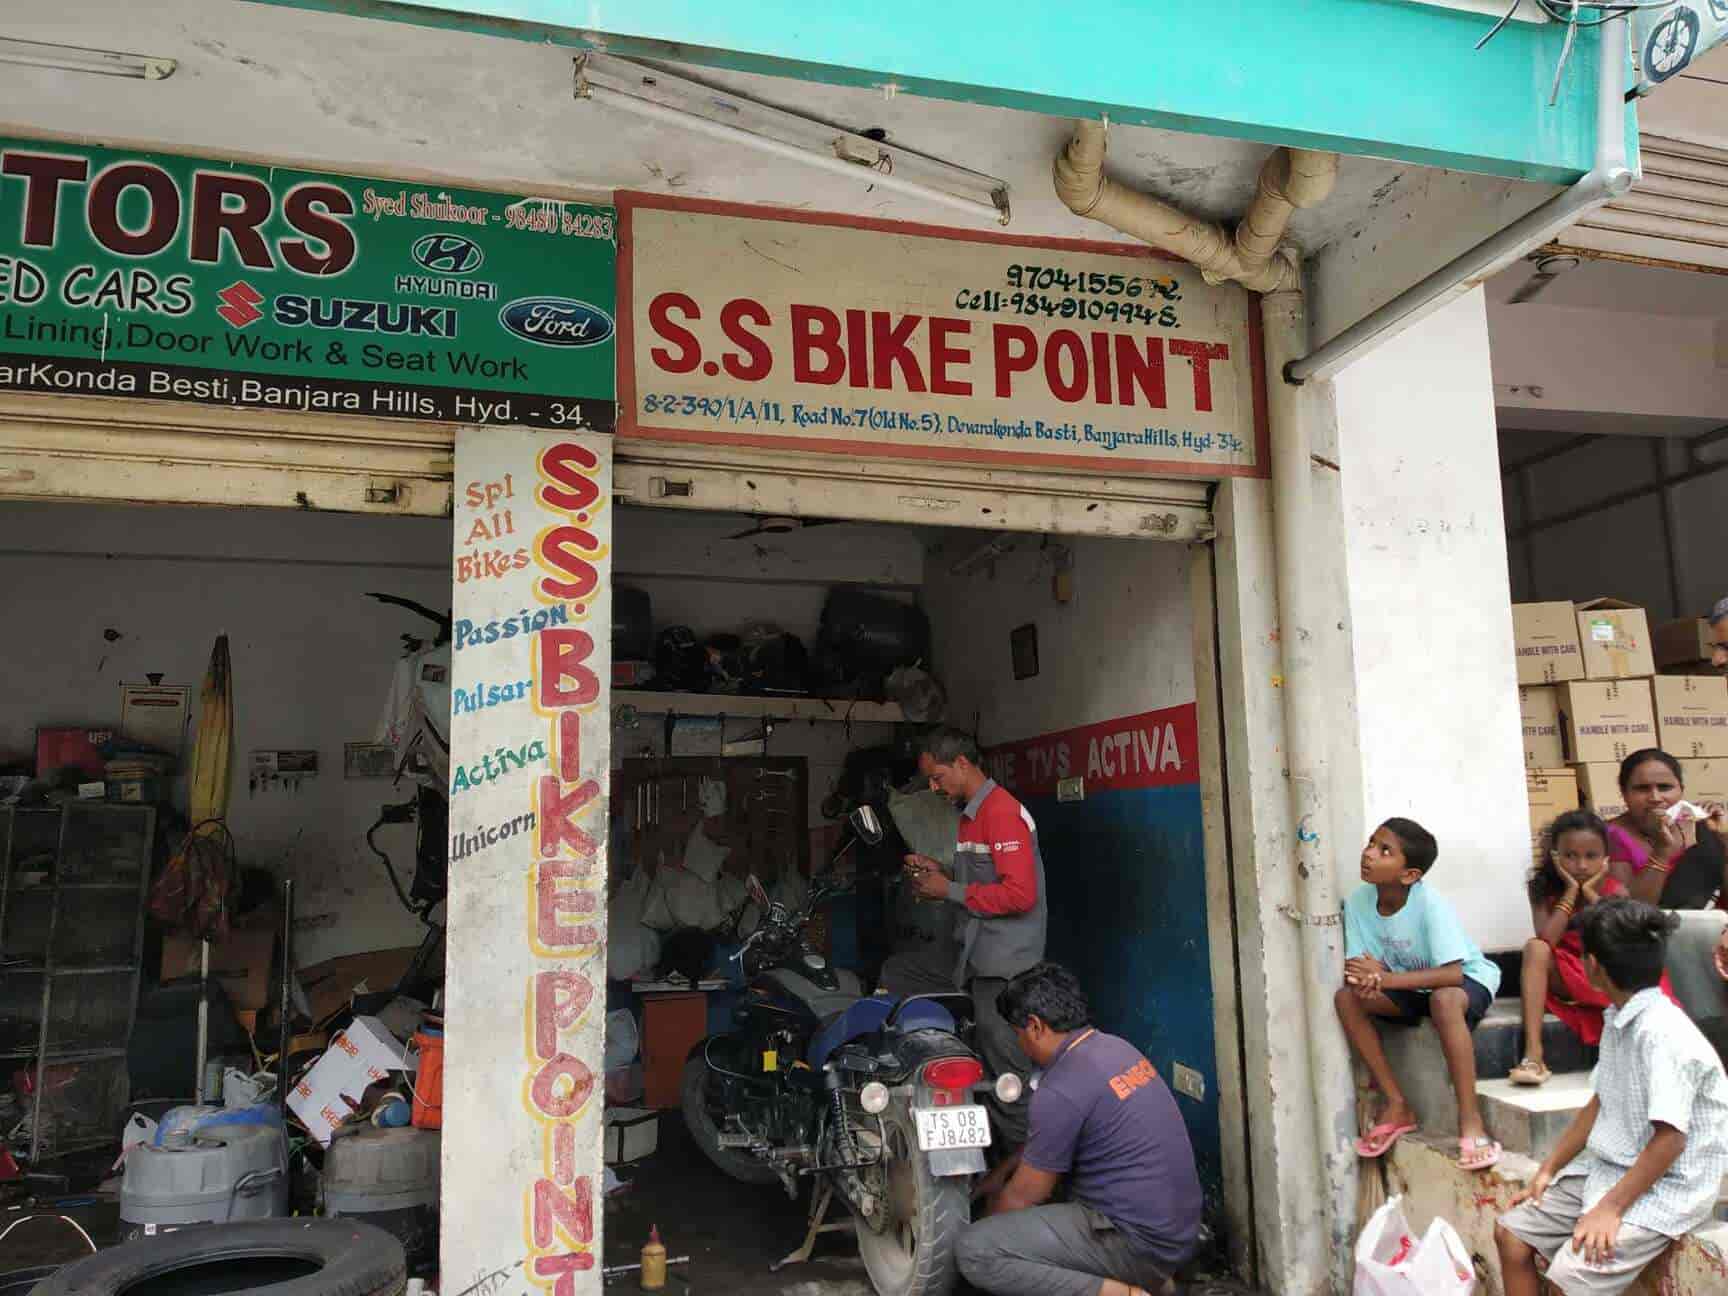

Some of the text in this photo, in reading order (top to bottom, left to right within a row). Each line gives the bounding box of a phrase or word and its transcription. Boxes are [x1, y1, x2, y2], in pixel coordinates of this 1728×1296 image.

[2, 152, 357, 276] TORS
[363, 188, 406, 221] Syed
[63, 266, 192, 315] CARS
[396, 275, 497, 300] HYUNDAI
[274, 295, 457, 338] SUZUKI
[524, 303, 592, 341] Ford
[226, 331, 313, 364] Work
[325, 341, 348, 366] &
[361, 344, 436, 374] Seat
[449, 351, 529, 381] Work
[648, 291, 1229, 413] S.S BIKE POINT
[372, 389, 443, 418] Hills,
[455, 395, 519, 423] Hyd.
[792, 404, 827, 428] Road
[464, 510, 515, 546] All
[453, 679, 533, 716] Pulsar
[451, 738, 548, 796] Activa
[1087, 721, 1182, 781] ACTIVA
[450, 810, 537, 863] Unicorn
[930, 1110, 977, 1129] TS 08
